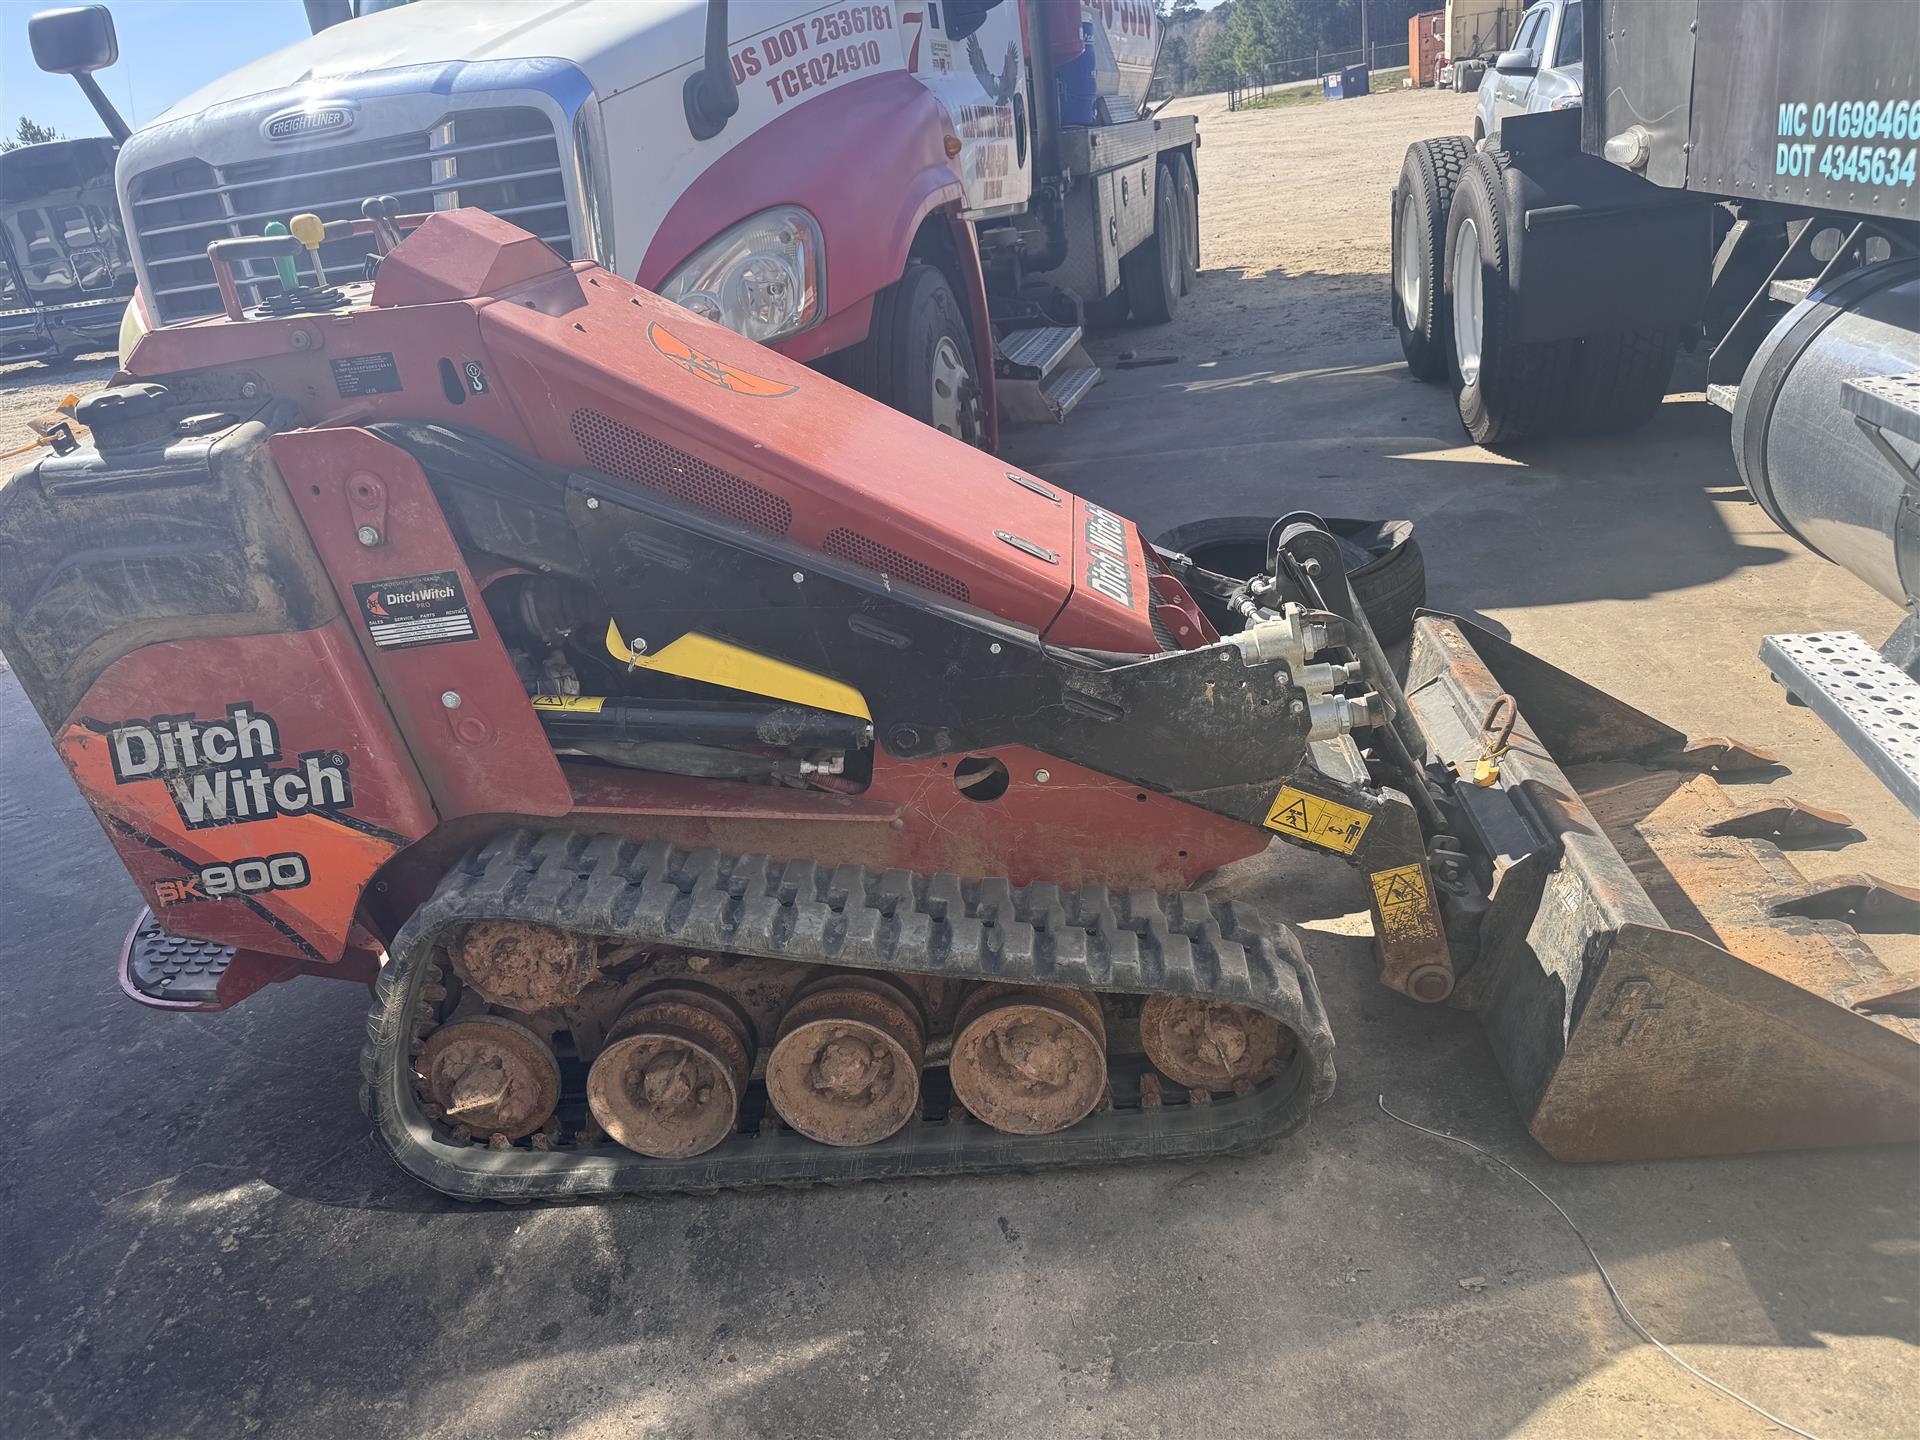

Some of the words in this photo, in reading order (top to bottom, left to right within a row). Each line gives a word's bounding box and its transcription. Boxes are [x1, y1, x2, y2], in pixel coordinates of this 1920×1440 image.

[731, 46, 763, 87] US
[761, 22, 809, 67] DOT
[811, 5, 893, 45] 2536781
[902, 12, 923, 74] 7
[766, 40, 881, 105] TCEQ24910
[272, 112, 341, 135] FREIGHTLINER
[1777, 102, 1808, 137] MC
[1811, 99, 1920, 140] 01698466
[1775, 142, 1817, 178] DOT
[1818, 143, 1918, 187] 4345634
[1089, 507, 1124, 557] Witch
[1091, 549, 1129, 607] Ditch
[394, 615, 414, 623] SERVICE
[445, 607, 468, 616] RENTALS
[415, 601, 432, 609] PRO
[113, 709, 275, 777] Ditch
[172, 757, 346, 824] Witch
[155, 856, 306, 902] SK900
